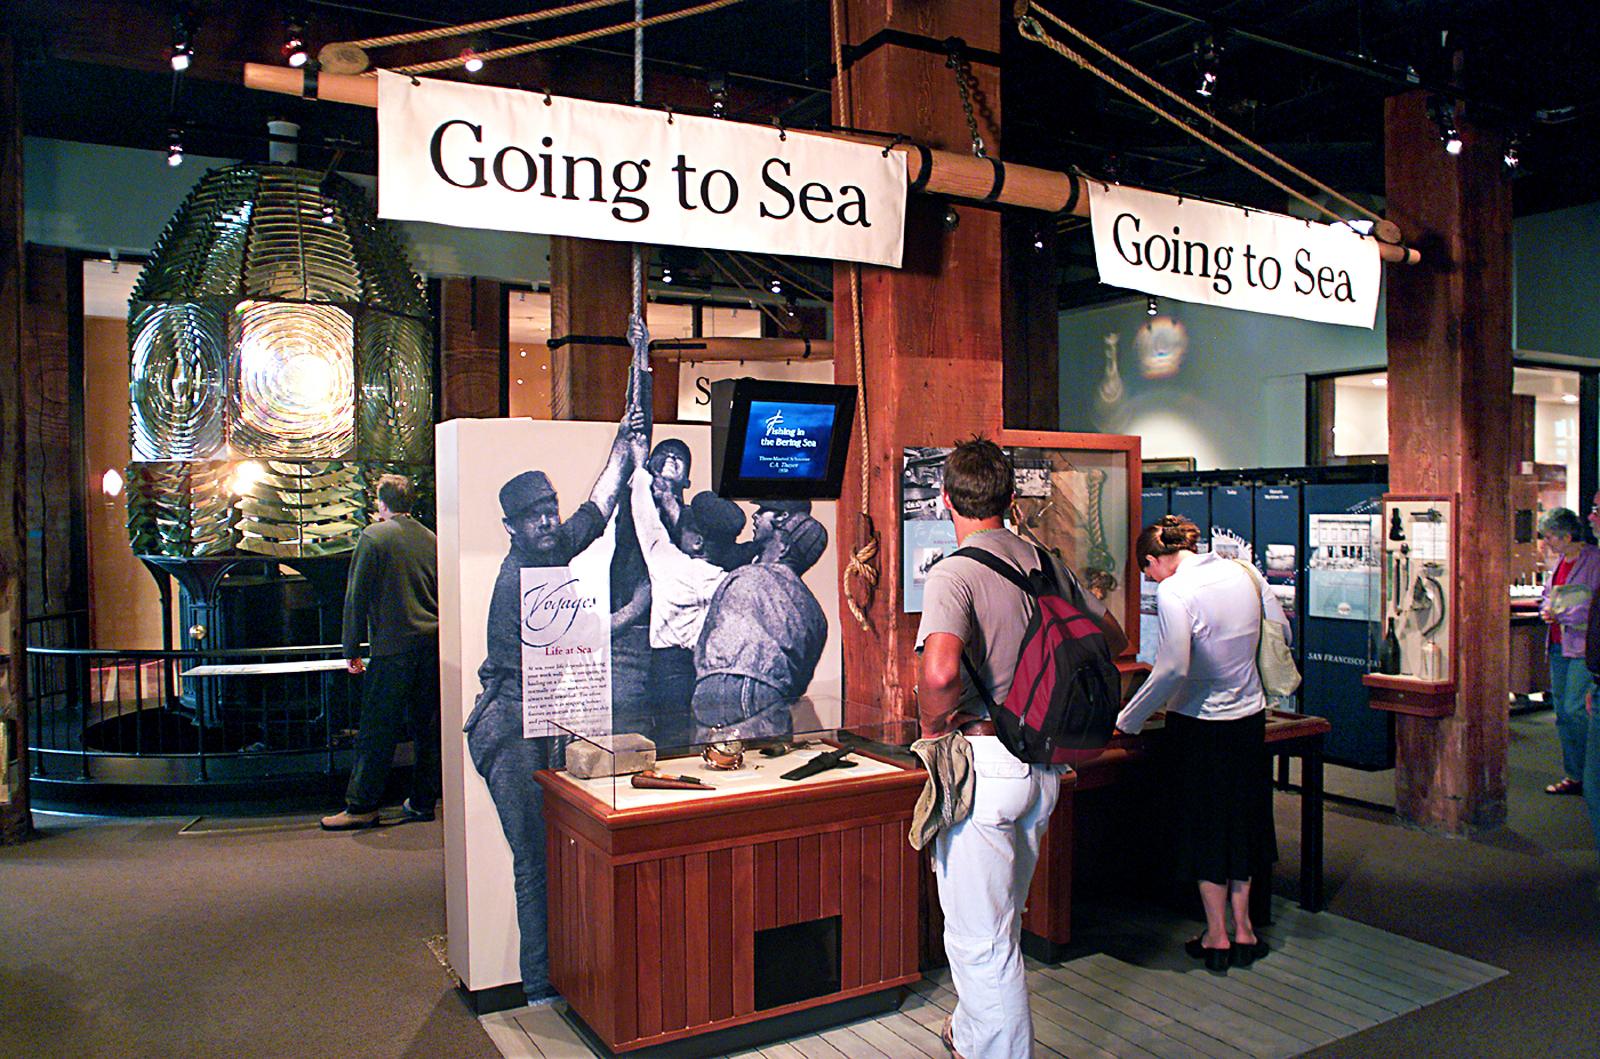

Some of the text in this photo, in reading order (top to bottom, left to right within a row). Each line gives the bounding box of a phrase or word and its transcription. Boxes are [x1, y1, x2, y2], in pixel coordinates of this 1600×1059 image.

[429, 119, 872, 228] Going to Sea
[1113, 213, 1356, 303] Going to Sea
[765, 409, 806, 437] Fishing in
[760, 437, 817, 448] the Bering Sea
[520, 578, 597, 648] Voyages
[545, 645, 593, 656] Life at Sea
[1308, 652, 1322, 661] SAN
[1323, 653, 1366, 666] FRANCISCO
